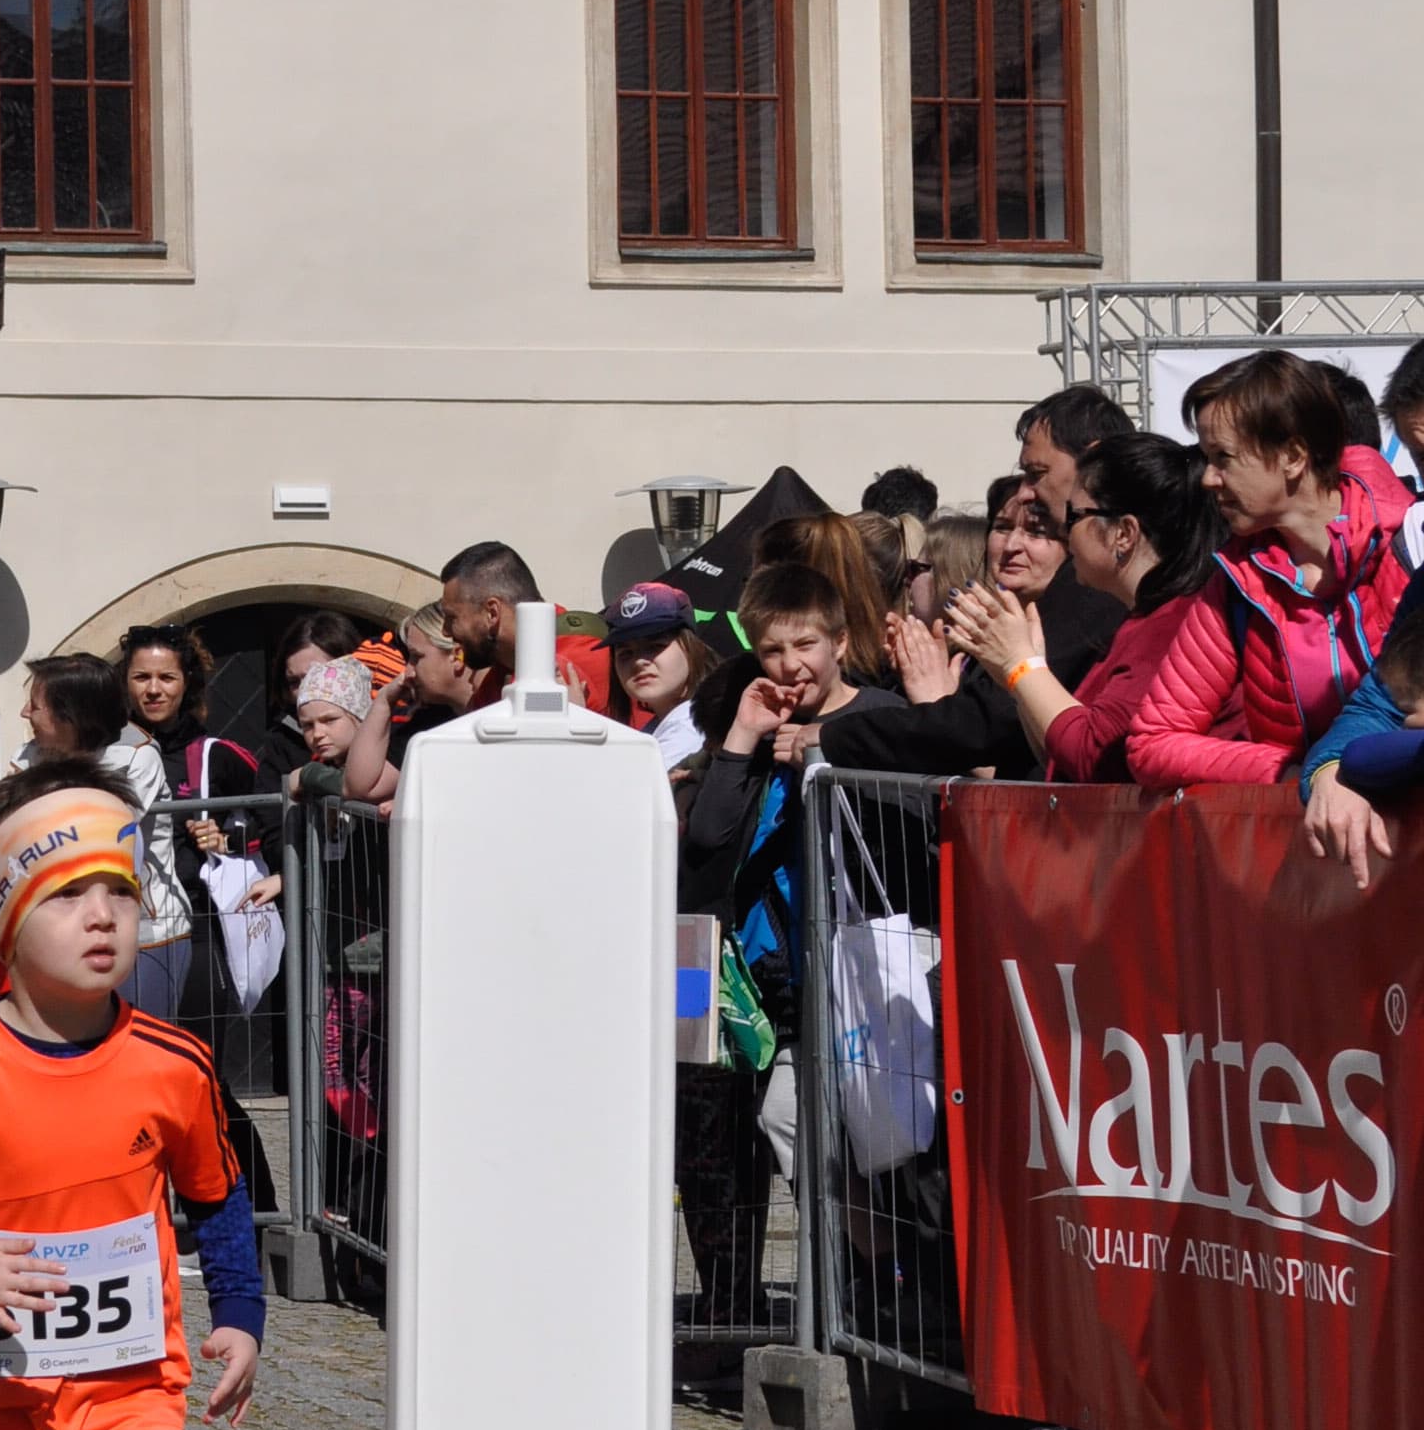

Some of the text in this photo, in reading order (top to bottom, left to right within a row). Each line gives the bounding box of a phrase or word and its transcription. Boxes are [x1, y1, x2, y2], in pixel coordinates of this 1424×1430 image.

[19, 825, 79, 869] RUN
[1001, 959, 1396, 1227] Nartes
[43, 1242, 90, 1260] PVZP
[1078, 1226, 1170, 1272] QUALITY
[1273, 1255, 1356, 1307] SPRING
